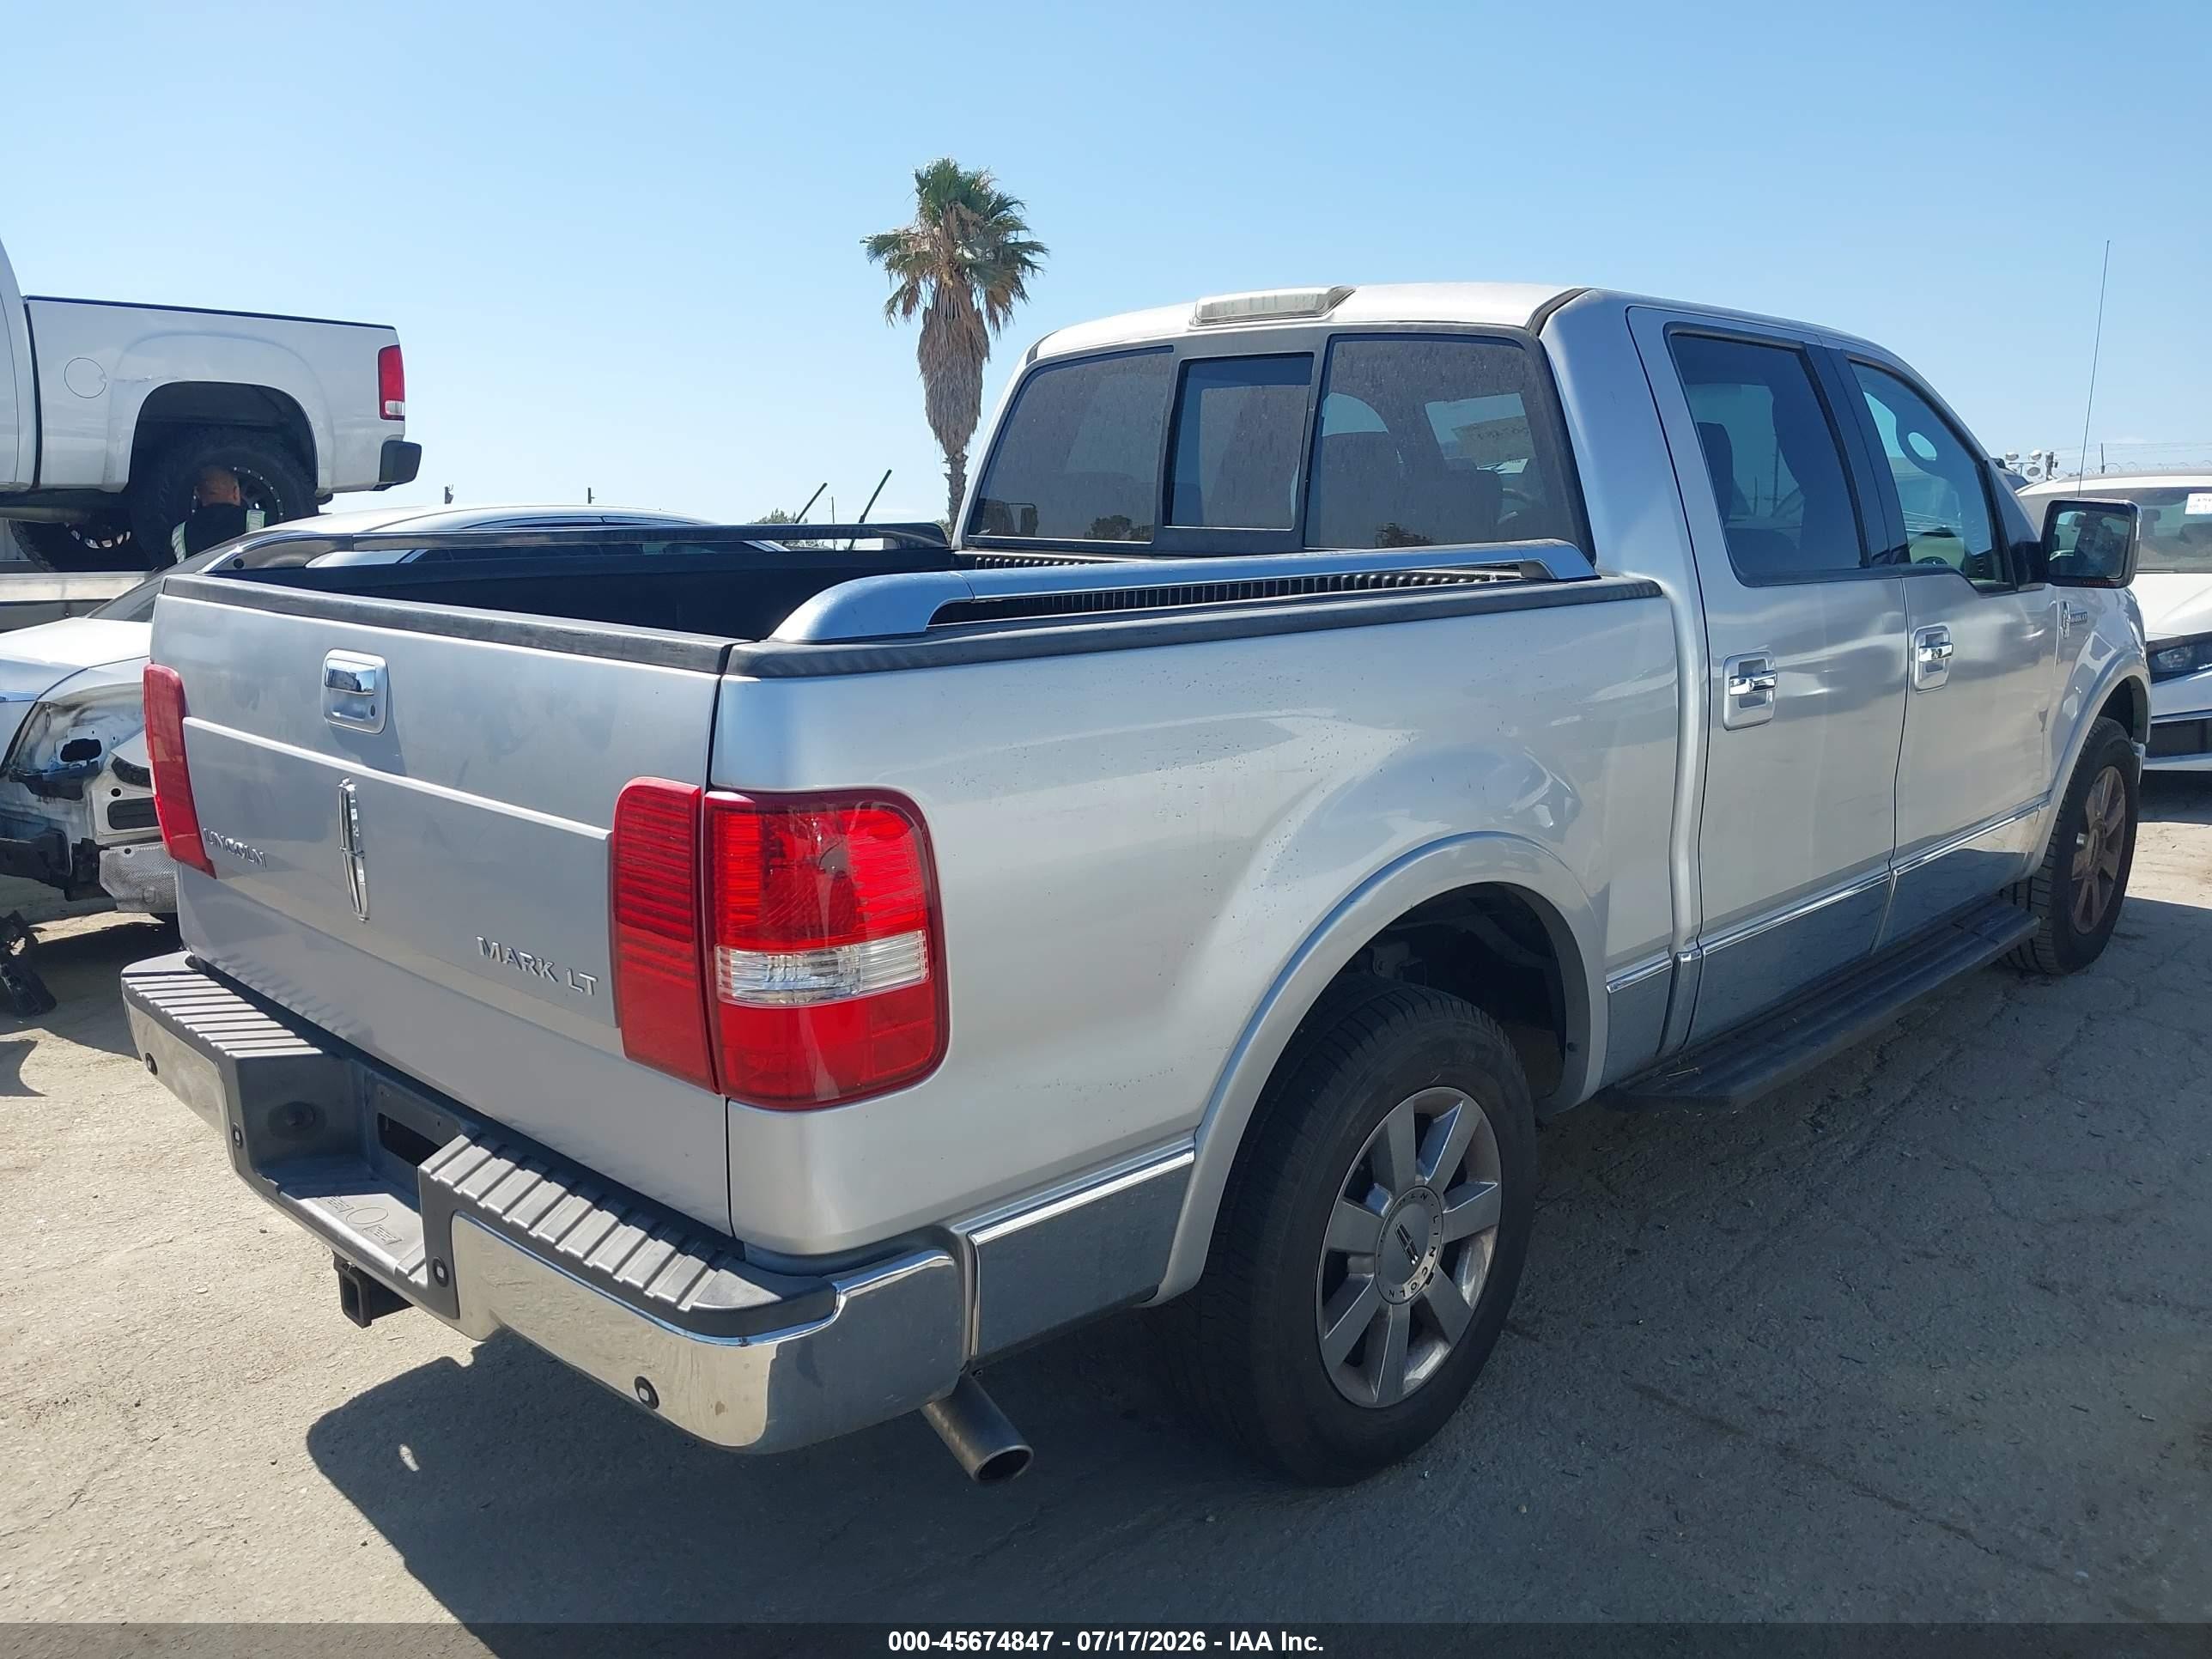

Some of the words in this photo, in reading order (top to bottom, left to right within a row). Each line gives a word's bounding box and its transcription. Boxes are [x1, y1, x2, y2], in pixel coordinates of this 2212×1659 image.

[203, 827, 267, 869] LINCOLN
[476, 935, 558, 982] MARK
[566, 967, 599, 996] LT
[1389, 1214, 1440, 1298] LINCOLN
